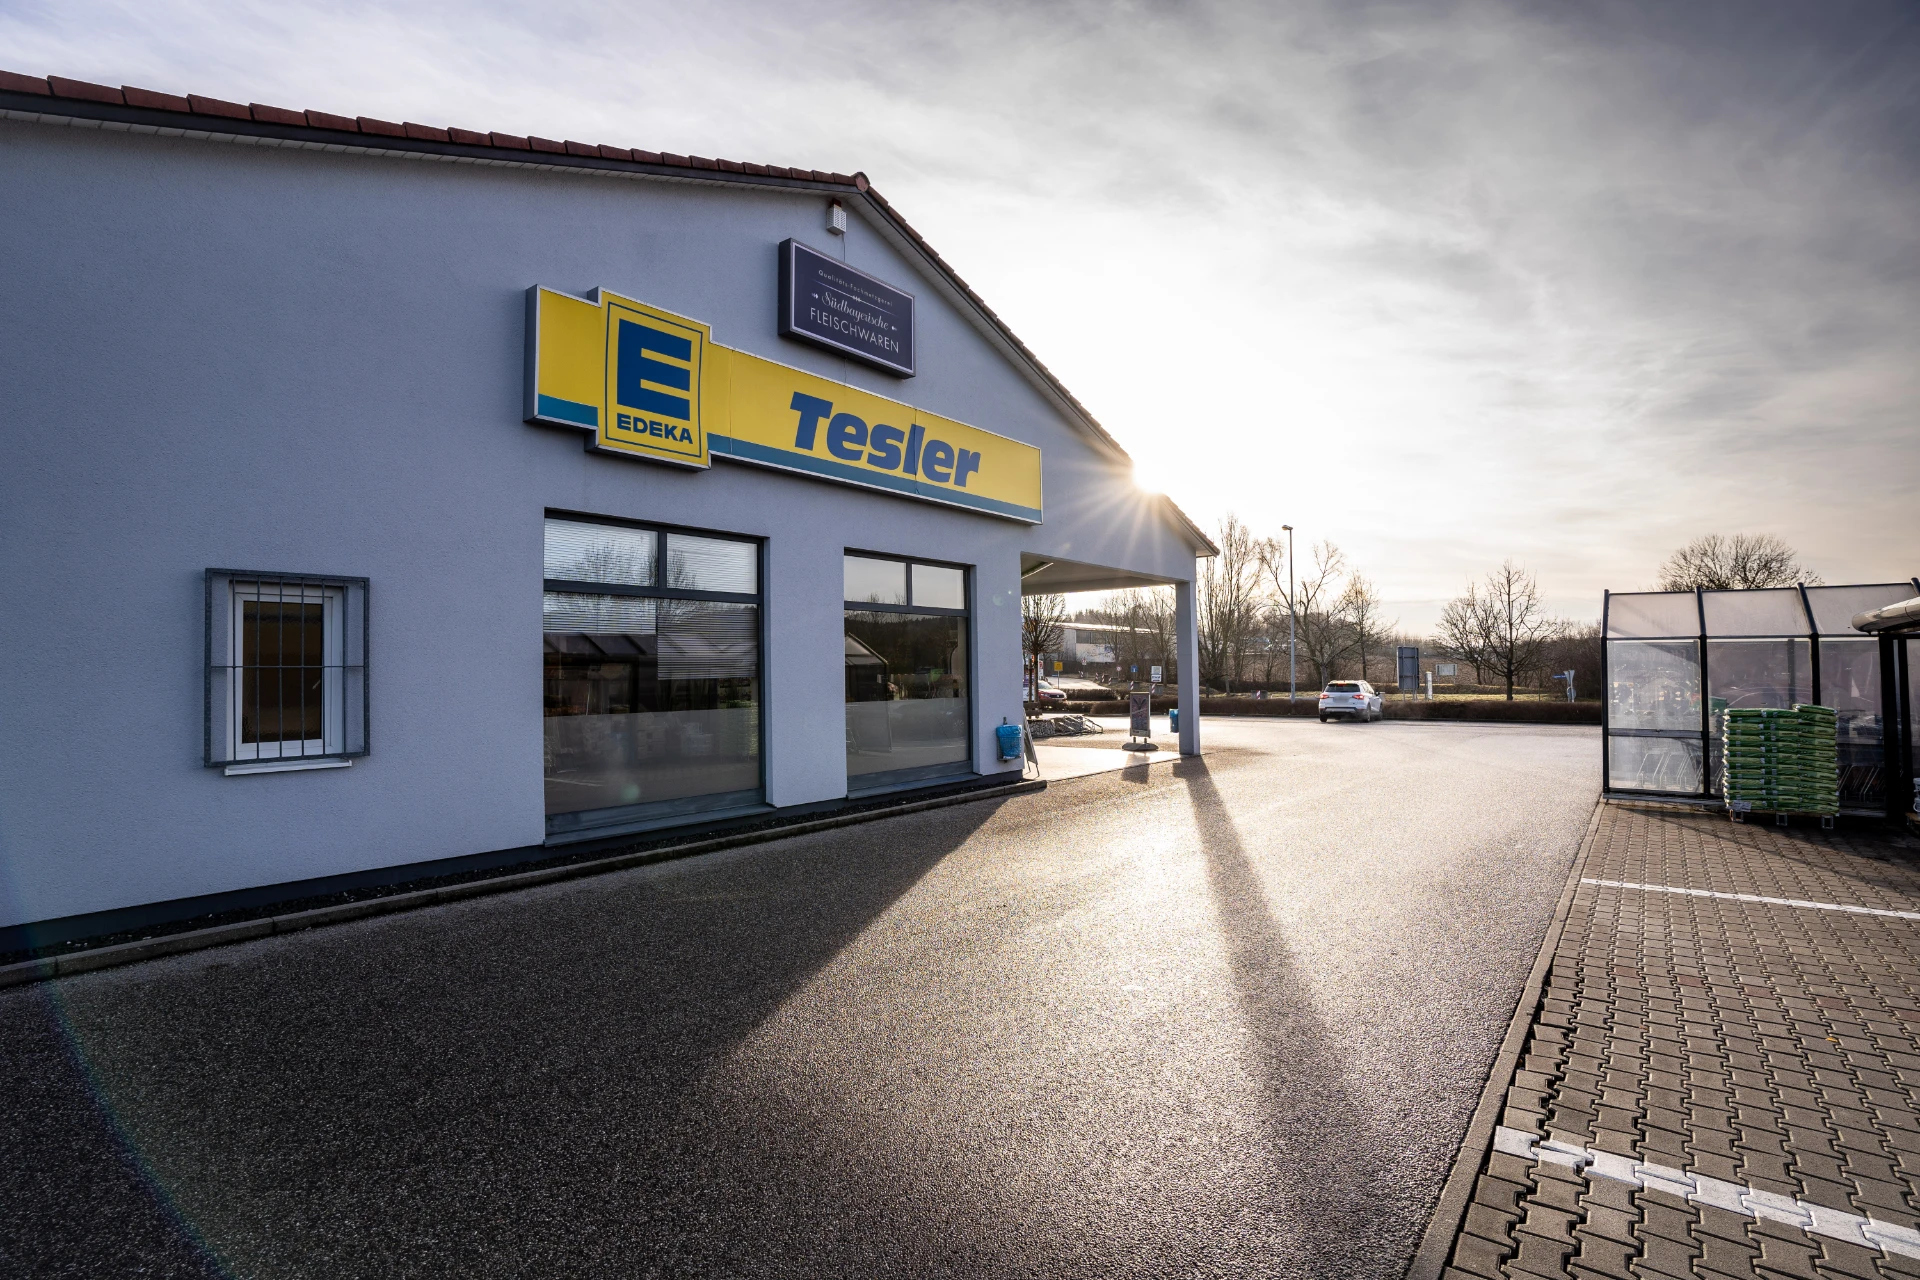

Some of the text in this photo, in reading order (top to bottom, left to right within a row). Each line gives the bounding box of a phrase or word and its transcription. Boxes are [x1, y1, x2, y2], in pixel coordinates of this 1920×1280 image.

[810, 307, 899, 354] FLEISCHWAREN
[821, 291, 889, 331] Südbayerische
[616, 317, 692, 421] E
[616, 415, 693, 445] EDEKA
[790, 391, 981, 488] Tesler
